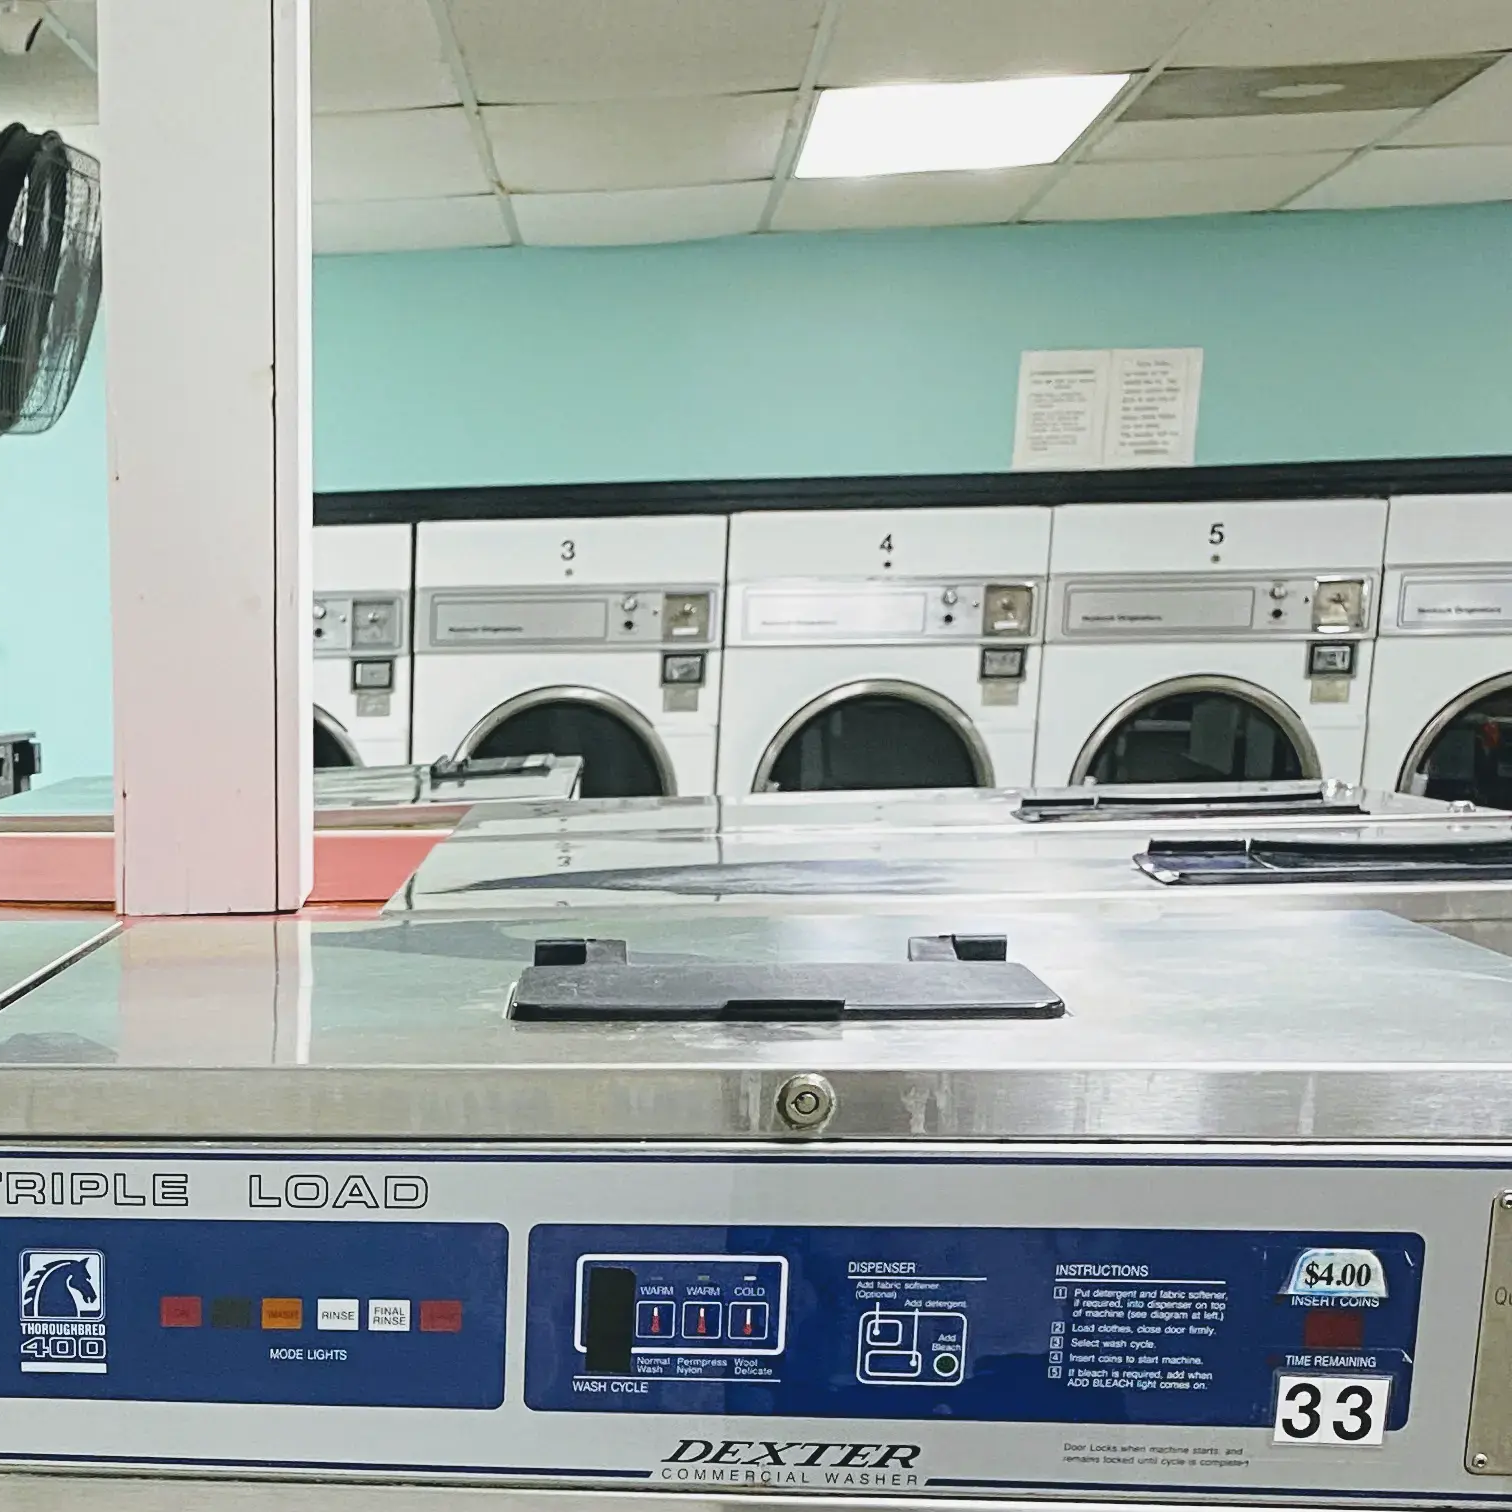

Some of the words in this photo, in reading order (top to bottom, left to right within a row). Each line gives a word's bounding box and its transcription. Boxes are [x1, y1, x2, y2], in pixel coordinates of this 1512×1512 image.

[1209, 523, 1224, 546] 5
[880, 534, 893, 554] 4
[561, 541, 575, 561] 3
[249, 1174, 428, 1209] LOAD
[848, 1261, 916, 1273] DISPENSER
[1056, 1265, 1149, 1277] INSTRUCTIONS
[1305, 1261, 1372, 1288] $4.00
[857, 1281, 873, 1289] Add
[640, 1287, 673, 1295] WARM
[686, 1287, 720, 1295] WARM
[734, 1287, 765, 1296] COLD
[856, 1290, 896, 1299] (Optional)
[1074, 1289, 1090, 1297] Put
[1093, 1289, 1136, 1299] detergent
[1140, 1290, 1156, 1298] and
[1160, 1290, 1185, 1299] fabric
[1292, 1296, 1336, 1307] INSERT
[1340, 1296, 1379, 1307] COINS
[321, 1311, 355, 1320] RINSE
[374, 1307, 405, 1316] FINAL
[1072, 1309, 1082, 1317] of
[1085, 1310, 1124, 1318] machine
[373, 1316, 406, 1325] RINSE
[20, 1323, 106, 1336] THOROUGHBRED
[1072, 1324, 1094, 1332] Load
[1137, 1325, 1161, 1333] close
[1165, 1326, 1185, 1334] door
[938, 1334, 956, 1342] Add
[1071, 1338, 1099, 1347] Select
[1103, 1339, 1126, 1348] wash
[20, 1336, 106, 1359] 400
[932, 1343, 961, 1351] Bleach
[270, 1349, 303, 1359] MODE
[307, 1349, 347, 1361] LIGHTS
[1070, 1353, 1094, 1362] Insert
[1098, 1354, 1122, 1363] coins
[1138, 1355, 1158, 1363] start
[637, 1357, 670, 1365] Normal
[734, 1358, 758, 1366] Wool
[1285, 1355, 1311, 1366] TIME
[1314, 1355, 1376, 1368] REMAINING
[637, 1365, 662, 1373] Wash
[677, 1366, 702, 1375] Nylon
[735, 1367, 772, 1375] Delicate
[1078, 1369, 1108, 1377] bleach
[1112, 1369, 1119, 1377] is
[1188, 1371, 1212, 1380] when
[573, 1381, 606, 1392] WASH
[611, 1381, 648, 1393] CYCLE
[1067, 1379, 1089, 1387] ADD
[1093, 1379, 1133, 1388] BLEACH
[1137, 1380, 1156, 1390] light
[1282, 1382, 1373, 1441] 33
[1064, 1443, 1086, 1451] Door
[1090, 1444, 1116, 1452] Locks
[661, 1439, 922, 1469] DEXTER
[661, 1468, 810, 1484] COMMERCIAL
[826, 1472, 918, 1486] WASHER
